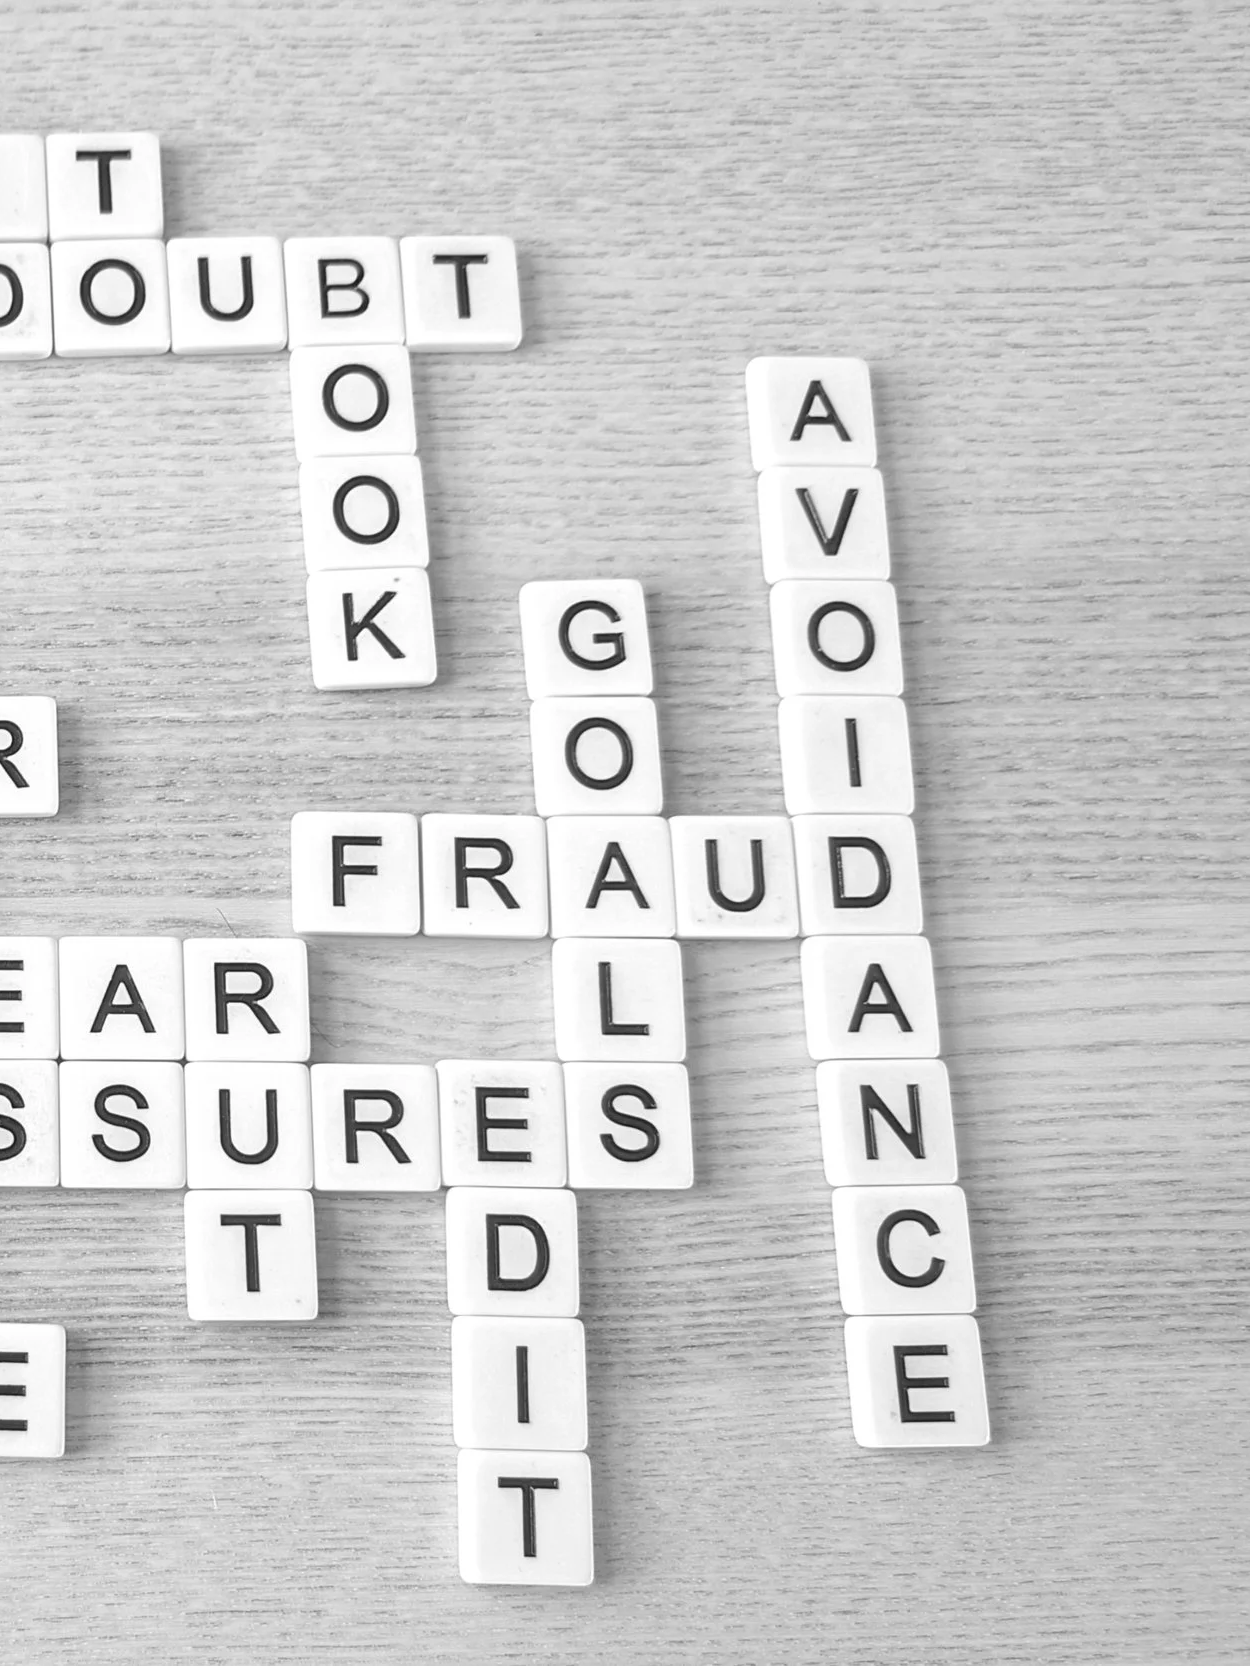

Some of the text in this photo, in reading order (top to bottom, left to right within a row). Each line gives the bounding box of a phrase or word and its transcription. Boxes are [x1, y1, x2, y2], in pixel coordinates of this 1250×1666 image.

[319, 259, 405, 660] BOOK
[332, 836, 891, 912] FRAUD
[559, 601, 659, 1162] GOALS
[791, 381, 955, 1422] AVOIDANCE
[476, 1087, 558, 1557] EDIT
